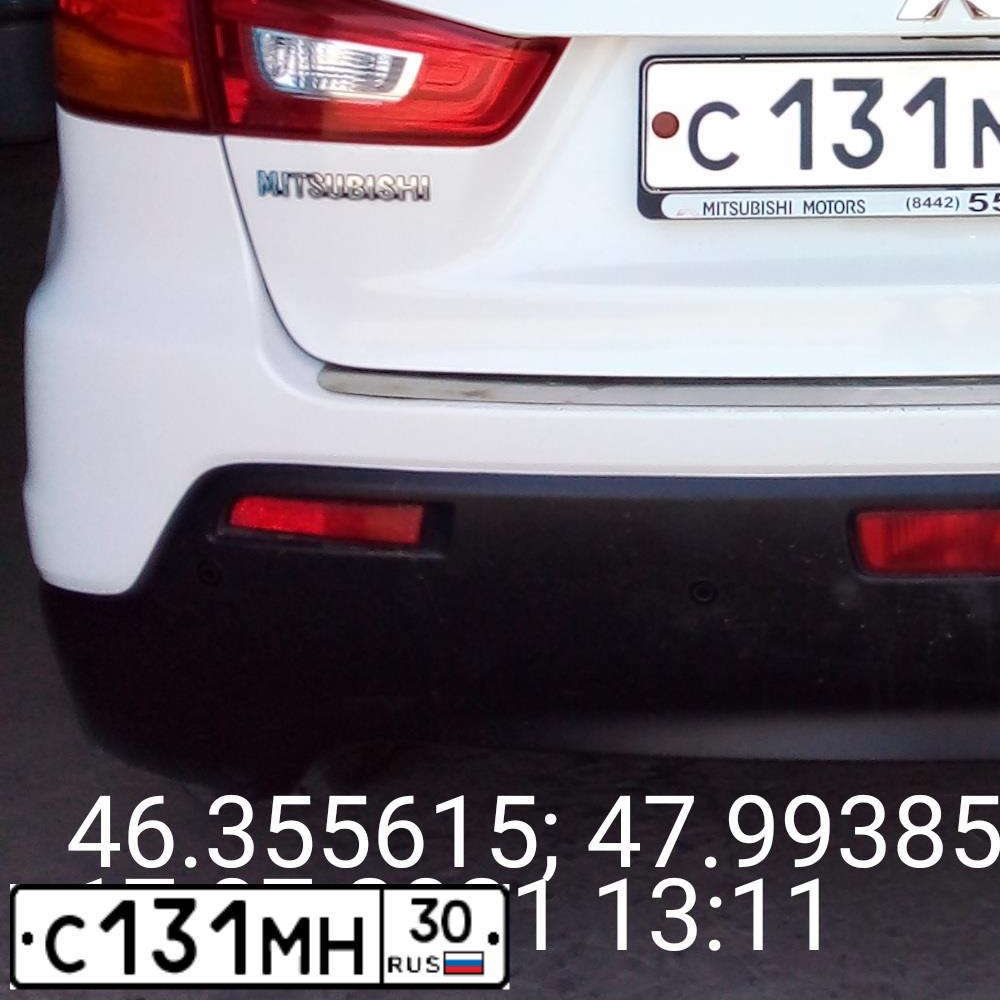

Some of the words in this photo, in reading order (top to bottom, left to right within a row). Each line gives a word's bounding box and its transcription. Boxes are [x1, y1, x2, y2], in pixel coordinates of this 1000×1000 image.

[256, 170, 431, 201] MITSUBISHI
[702, 200, 793, 216] MITSUBISHI
[802, 199, 866, 215] MOTORS
[905, 196, 960, 212] (8442)
